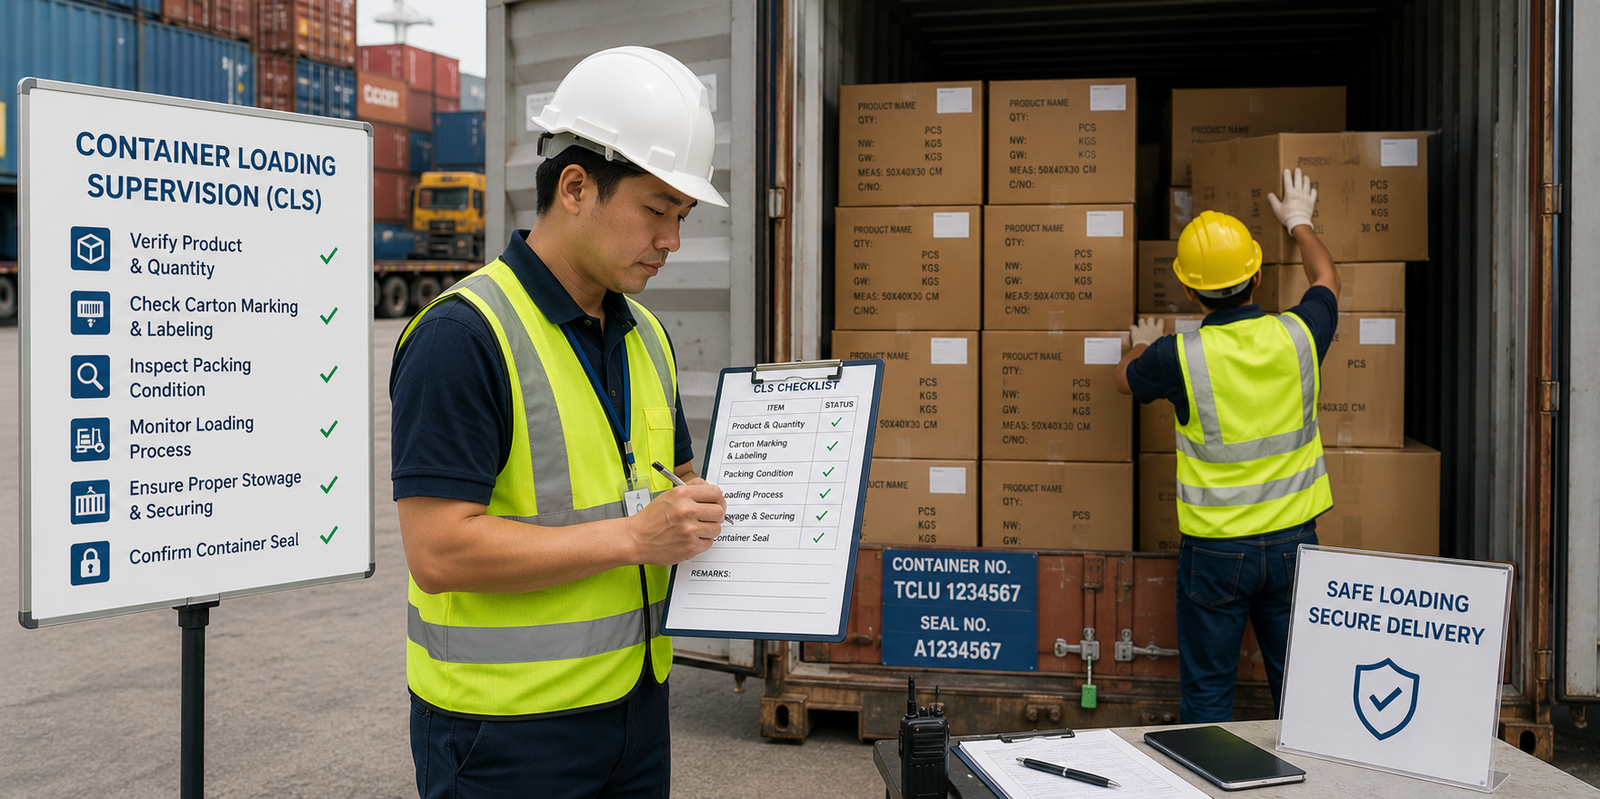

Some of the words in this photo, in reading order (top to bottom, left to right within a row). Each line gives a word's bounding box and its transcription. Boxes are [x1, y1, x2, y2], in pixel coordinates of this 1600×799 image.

[858, 102, 893, 110] PRODUCT
[1010, 99, 1045, 107] PRODUCT
[1047, 99, 1069, 107] NAME
[858, 116, 877, 124] QTY:
[1010, 113, 1028, 122] QTY:
[925, 126, 942, 134] PCS
[1079, 123, 1096, 132] PCS
[1192, 125, 1226, 134] PRODUCT
[1228, 125, 1250, 134] NAME
[925, 139, 942, 148] KGS
[1010, 136, 1026, 144] NW:
[1079, 137, 1096, 145] KGS
[76, 131, 230, 169] CONTAINER
[238, 148, 336, 176] LOADING
[858, 154, 874, 162] GW:
[925, 152, 942, 161] KGS
[1010, 151, 1027, 159] GW:
[1079, 150, 1096, 159] KGS
[858, 168, 883, 177] MEAS:
[886, 168, 925, 177] 50X40X30
[929, 167, 942, 176] CM
[1010, 166, 1036, 174] MEAS:
[1038, 166, 1079, 174] 50X40X30
[1083, 165, 1096, 173] CM
[858, 182, 882, 191] C/NO:
[1009, 180, 1034, 189] C/NO:
[1370, 180, 1388, 189] PCS
[88, 174, 258, 207] SUPERVISION
[267, 186, 321, 214] (CLS)
[1371, 194, 1388, 203] KGS
[1371, 208, 1388, 217] KGS
[854, 226, 888, 234] PRODUCT
[1005, 224, 1040, 232] PRODUCT
[1042, 224, 1064, 232] NAME
[1361, 223, 1370, 233] 30
[1375, 223, 1388, 232] CM
[130, 233, 177, 253] Verify
[183, 235, 242, 252] Product
[854, 239, 872, 248] QTY:
[1005, 238, 1024, 246] QTY:
[922, 251, 939, 259] PCS
[1074, 250, 1092, 258] PCS
[131, 258, 142, 273] &
[148, 259, 214, 279] Quantity
[922, 264, 939, 272] KGS
[1005, 262, 1022, 270] NW:
[1075, 263, 1092, 271] KGS
[854, 277, 870, 285] GW:
[922, 277, 939, 286] KGS
[1005, 276, 1022, 285] GW:
[1075, 277, 1092, 285] KGS
[854, 292, 879, 300] MEAS:
[882, 292, 922, 300] 50X40X30
[926, 292, 939, 300] CM
[1005, 292, 1032, 300] MEAS:
[1034, 292, 1075, 300] 50X40X30
[1078, 292, 1092, 300] CM
[130, 296, 180, 311] Check
[186, 297, 236, 312] Carton
[242, 299, 297, 317] Marking
[854, 306, 878, 315] C/NO:
[1005, 306, 1029, 314] C/NO:
[131, 321, 142, 336] &
[148, 321, 212, 340] Labeling
[887, 352, 909, 360] NAME
[1002, 352, 1038, 360] PRODUCT
[1040, 352, 1062, 361] NAME
[131, 358, 188, 377] Inspect
[194, 357, 251, 375] Packing
[1348, 359, 1366, 368] PCS
[1002, 366, 1021, 375] QTY:
[920, 378, 937, 386] PCS
[1073, 379, 1090, 387] PCS
[130, 382, 205, 398] Condition
[753, 383, 774, 393] CLS
[777, 381, 840, 392] CHECKLIST
[920, 391, 937, 400] KGS
[1003, 390, 1019, 398] NW:
[1073, 393, 1090, 401] KGS
[920, 405, 937, 414] KGS
[1002, 405, 1020, 414] GW:
[1073, 407, 1090, 415] KGS
[1351, 403, 1365, 412] CM
[131, 418, 191, 434] Monitor
[197, 416, 253, 433] Loading
[772, 420, 805, 429] Quantity
[880, 420, 920, 428] 50X40X30
[924, 420, 937, 429] CM
[1003, 421, 1029, 430] MEAS:
[1032, 421, 1073, 430] 50X40X30
[1077, 422, 1090, 430] CM
[757, 440, 787, 448] Marking
[1003, 435, 1027, 444] C/NO:
[130, 442, 192, 460] Process
[735, 452, 767, 460] Labeling
[724, 470, 753, 479] Packing
[130, 479, 184, 496] Ensure
[188, 475, 238, 494] Proper
[242, 469, 301, 490] Stowage
[886, 481, 908, 489] NAME
[1003, 484, 1038, 492] PRODUCT
[1041, 485, 1063, 493] NAME
[1003, 497, 1022, 506] QTY:
[130, 505, 141, 520] &
[147, 500, 212, 518] Securing
[918, 507, 936, 516] PCS
[752, 512, 757, 520] &
[760, 512, 795, 522] Securing
[1073, 511, 1090, 520] PCS
[918, 520, 936, 529] KGS
[1003, 521, 1020, 530] NW:
[919, 534, 936, 543] KGS
[1003, 536, 1021, 545] GW:
[130, 546, 191, 564] Confirm
[196, 537, 265, 559] Container
[270, 532, 299, 551] Seal
[893, 557, 979, 573] CONTAINER
[983, 558, 1011, 574] NO.
[691, 569, 731, 578] REMARKS:
[894, 581, 940, 599] TCLU
[945, 581, 1021, 603] 1234567
[1327, 581, 1374, 601] SAFE
[1379, 586, 1469, 613] LOADING
[921, 616, 959, 630] SEAL
[961, 616, 990, 632] NO.
[1309, 607, 1381, 632] SECURE
[1387, 617, 1485, 645] DELIVERY
[914, 639, 1001, 660] A1234567
